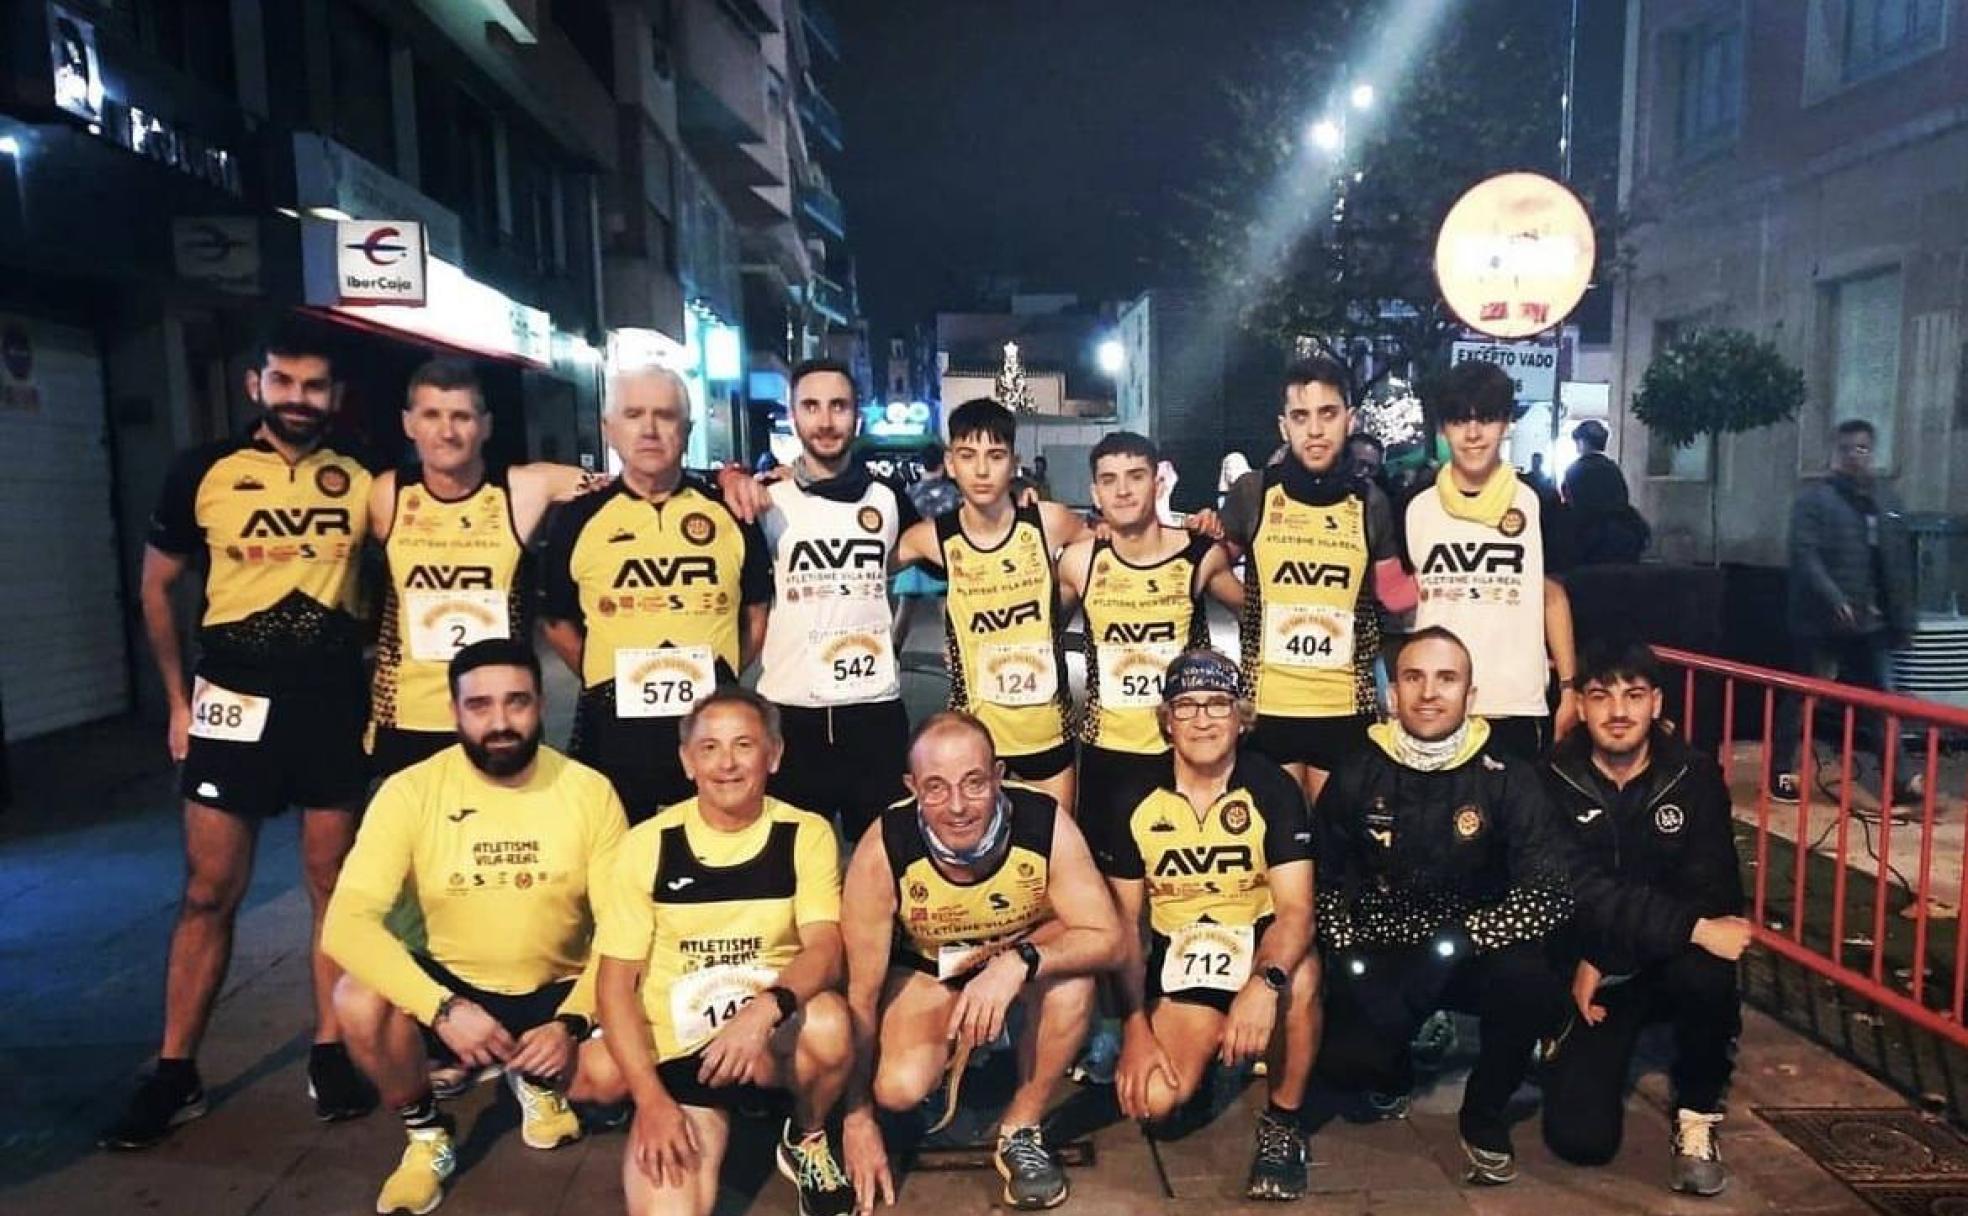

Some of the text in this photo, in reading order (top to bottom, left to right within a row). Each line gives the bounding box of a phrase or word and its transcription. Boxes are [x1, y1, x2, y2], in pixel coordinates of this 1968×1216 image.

[1458, 348, 1554, 368] EXCEPTO VADO
[241, 507, 351, 538] AVR
[788, 538, 886, 573] AVR
[1422, 542, 1525, 575] AVR
[405, 565, 493, 590] AVR
[612, 556, 718, 589] AVR
[1272, 560, 1351, 590] AVR
[970, 599, 1042, 634] AVR
[451, 624, 467, 647] 2
[1104, 621, 1176, 643] AVR
[1285, 634, 1333, 656] 404
[833, 655, 876, 681] 542
[643, 680, 694, 704] 578
[996, 672, 1036, 693] 124
[1122, 675, 1163, 697] 521
[196, 702, 242, 728] 488
[473, 841, 539, 853] ATLETISME
[1154, 845, 1253, 876] AVR
[680, 936, 763, 952] ATLETISME
[1183, 952, 1231, 976] 712
[703, 995, 756, 1028] 14
